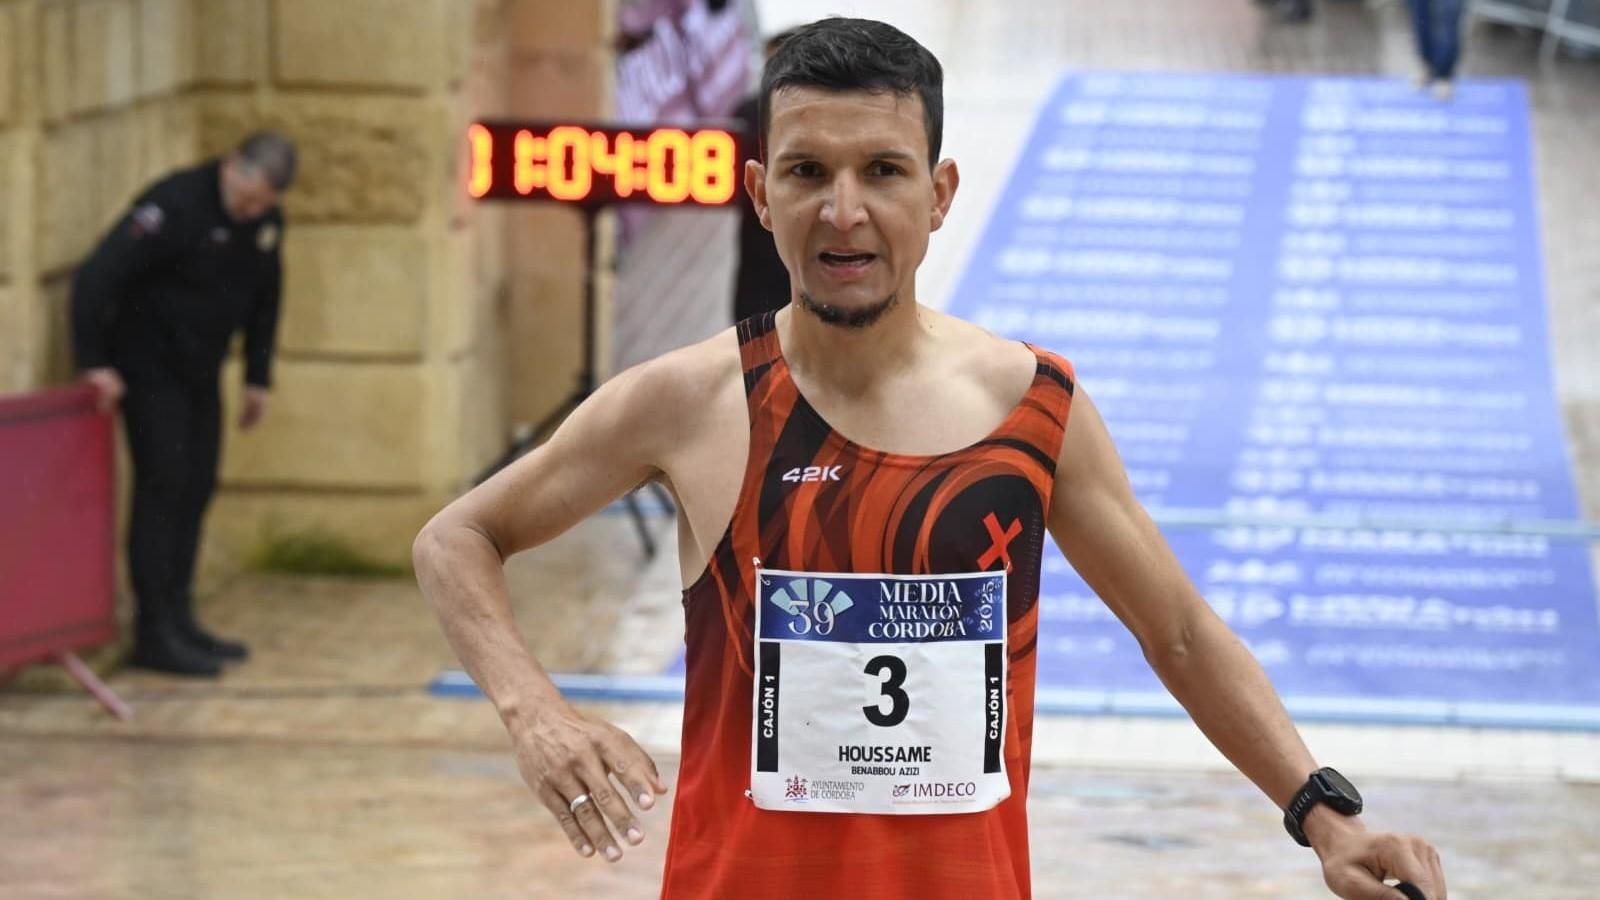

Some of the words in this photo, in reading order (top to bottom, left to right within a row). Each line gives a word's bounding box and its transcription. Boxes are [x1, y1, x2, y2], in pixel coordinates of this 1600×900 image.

[782, 465, 842, 482] 42K
[880, 581, 962, 603] MEDIA
[788, 600, 834, 635] 39
[980, 581, 994, 632] 2025
[862, 655, 910, 727] 3
[762, 687, 775, 738] CAJÓN
[988, 688, 999, 740] CAJÓN
[839, 745, 932, 763] HOUSSAME
[851, 766, 896, 776] BENABBOU
[899, 767, 920, 776] AZIZI
[913, 781, 976, 797] IMDECO
